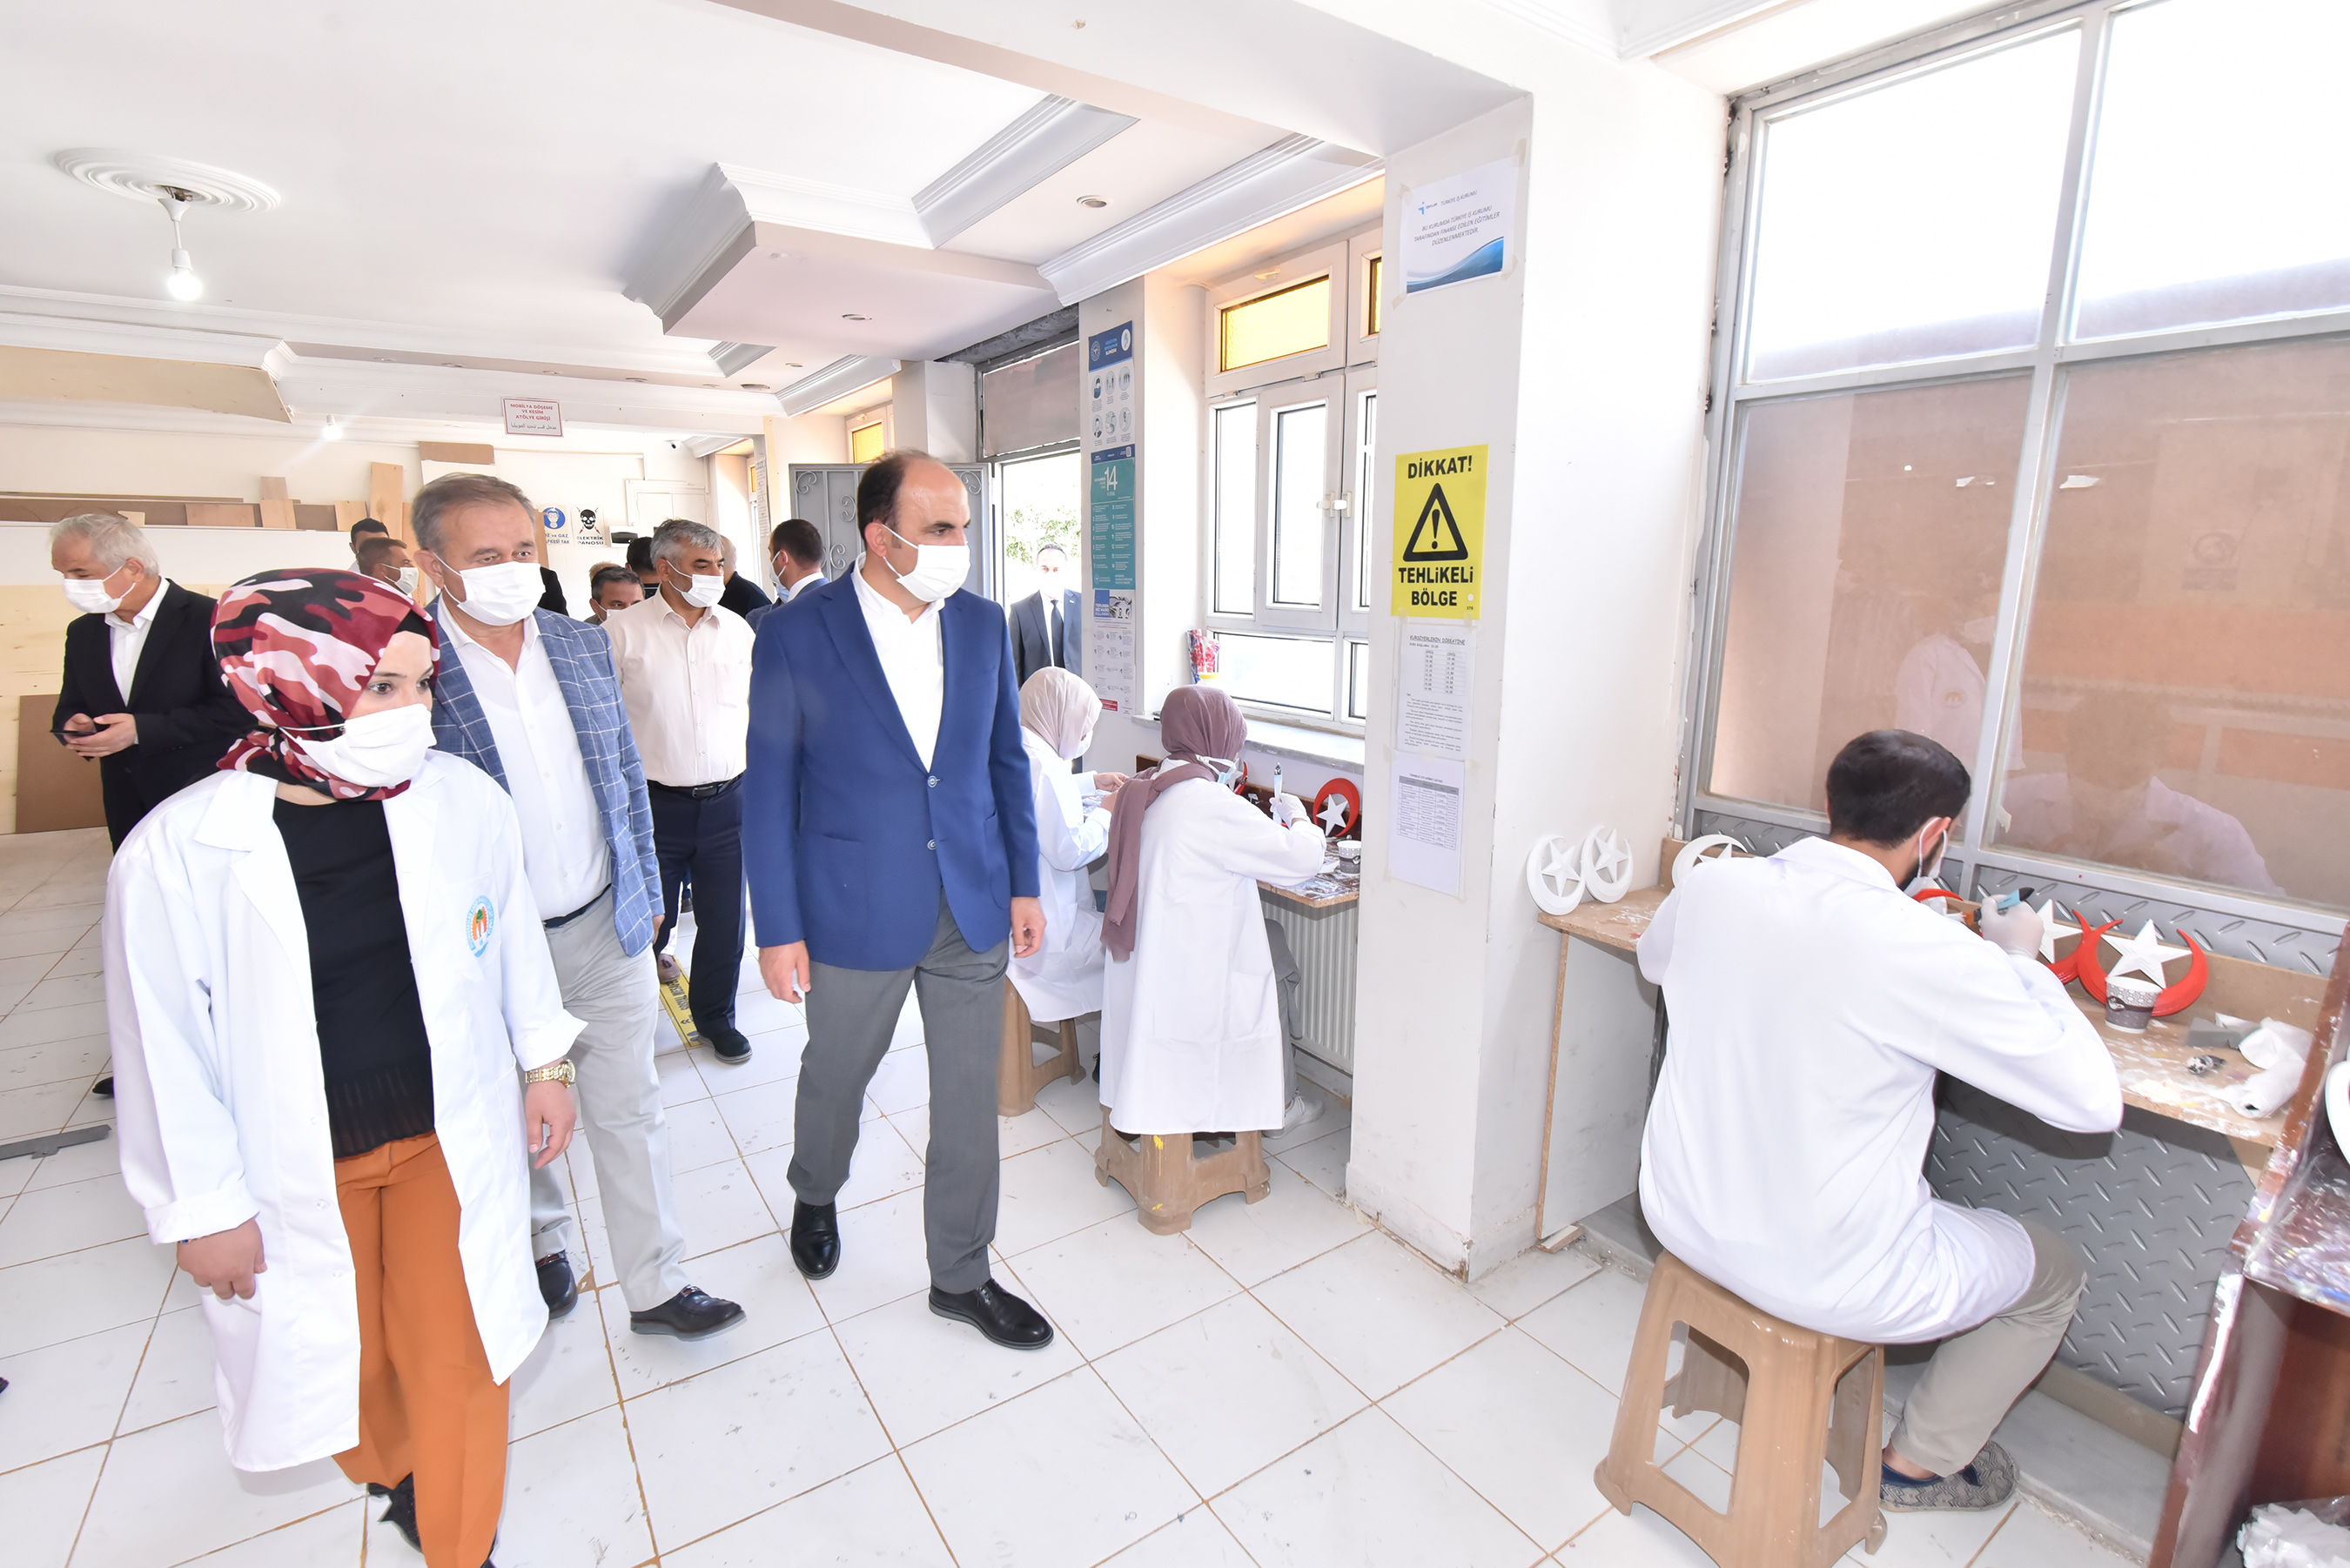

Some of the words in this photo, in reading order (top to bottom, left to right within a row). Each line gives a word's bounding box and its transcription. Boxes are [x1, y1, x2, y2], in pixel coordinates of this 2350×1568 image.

[1440, 197, 1455, 206] TÜRKİYE
[1460, 190, 1478, 199] KURUMU
[1413, 231, 1440, 242] TARAFINDAN
[1440, 224, 1457, 235] FİNANSE
[1457, 218, 1474, 230] EDİLEN
[1474, 211, 1500, 224] EĞİTİMLER
[1428, 218, 1450, 230] KURUMDA
[1450, 212, 1467, 223] TÜRKİYE
[1472, 204, 1492, 216] KURUMU
[1104, 466, 1118, 492] 14
[1407, 455, 1473, 479] DİKKAT!
[1411, 588, 1457, 606] BÖLGE
